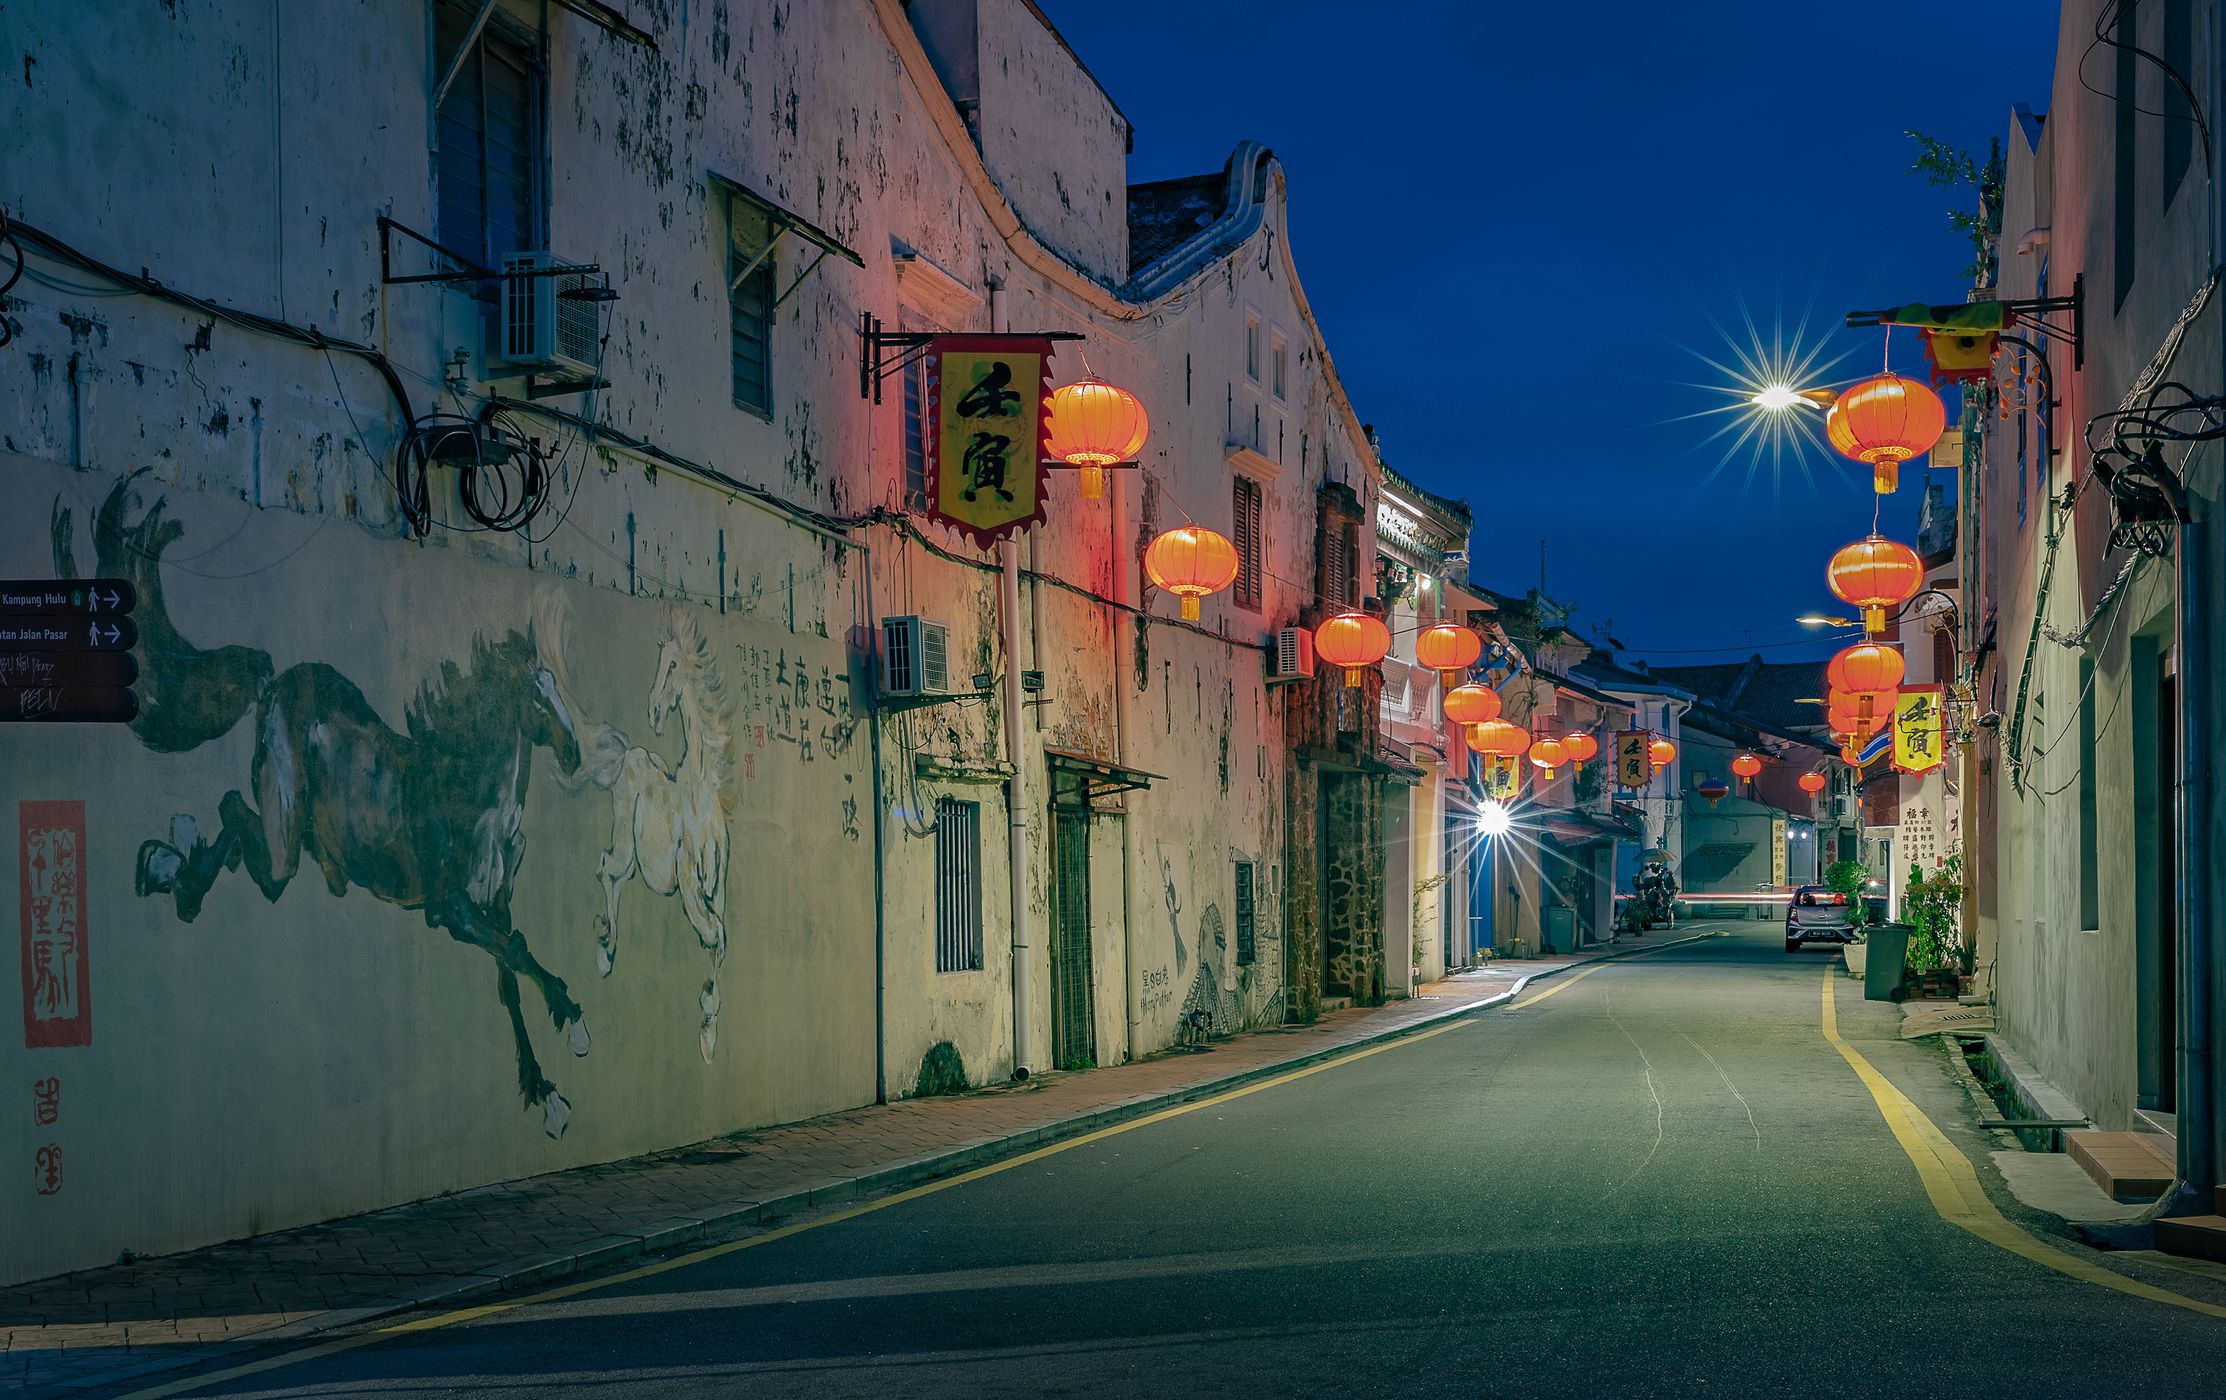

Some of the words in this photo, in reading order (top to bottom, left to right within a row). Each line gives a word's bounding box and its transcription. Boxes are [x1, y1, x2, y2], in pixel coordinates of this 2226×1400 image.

[2, 593, 42, 607] Kampung
[45, 593, 66, 604] Hulu
[19, 628, 41, 640] Jalan
[44, 628, 68, 640] Pasar
